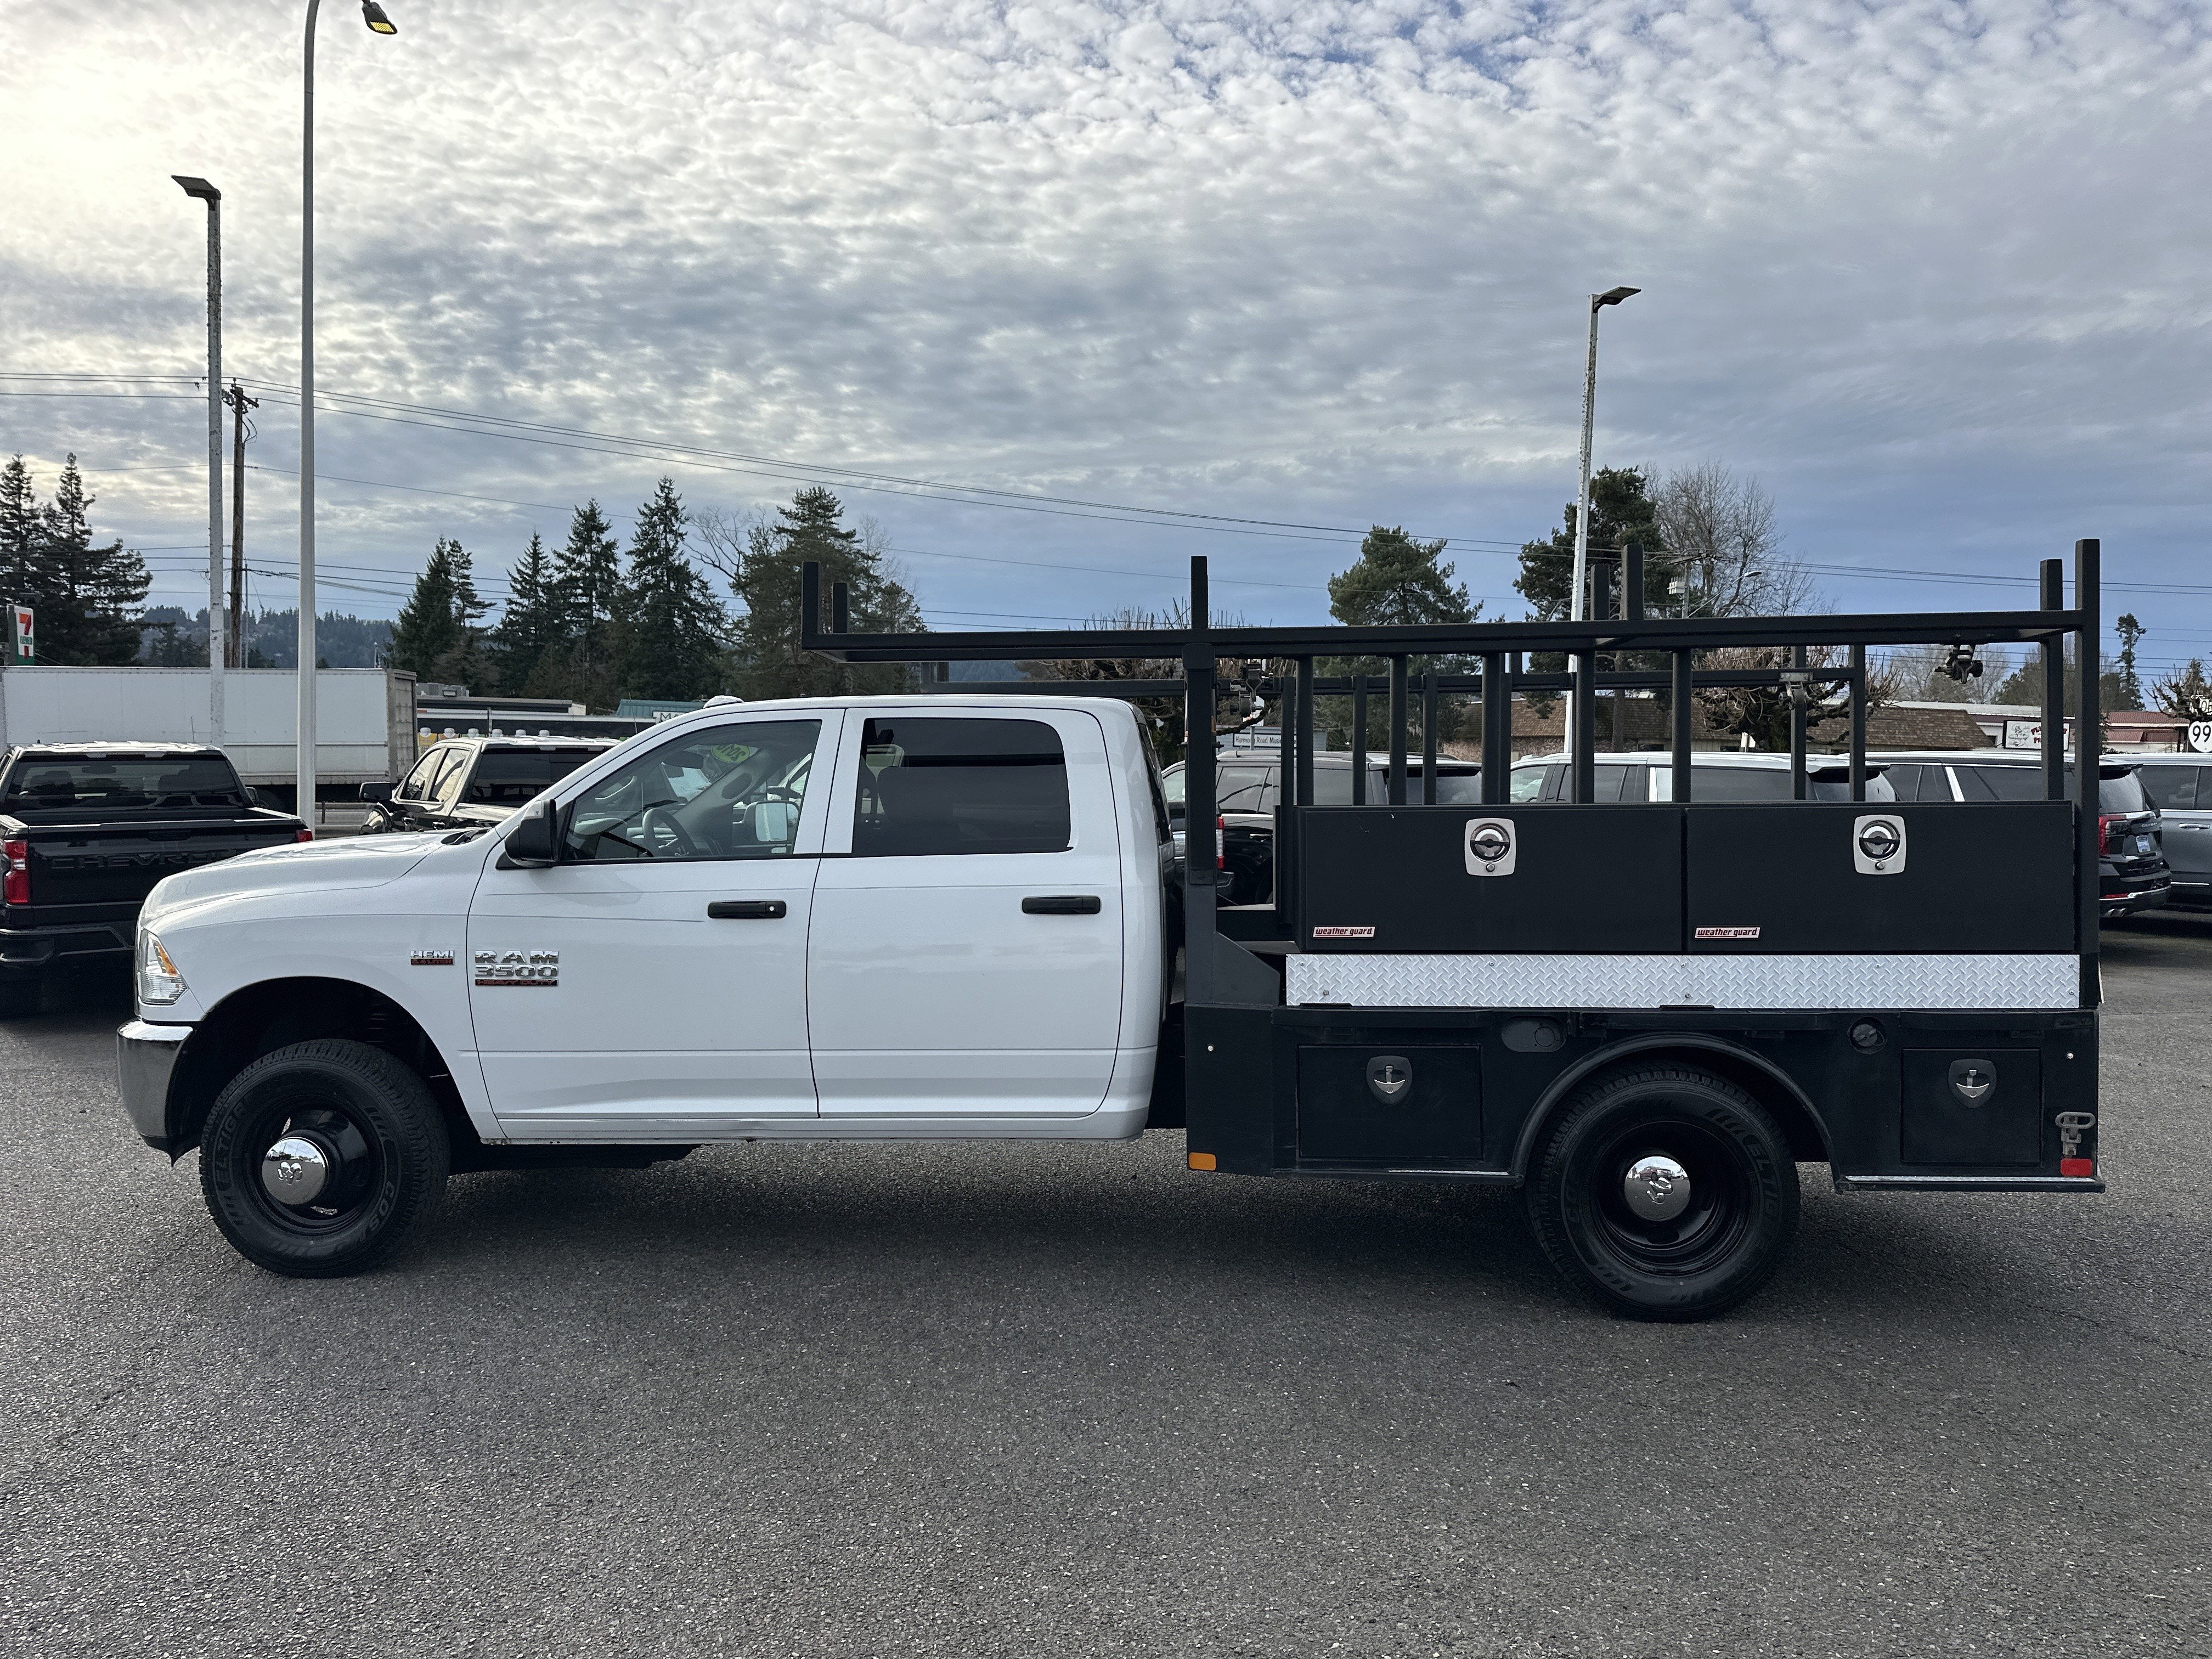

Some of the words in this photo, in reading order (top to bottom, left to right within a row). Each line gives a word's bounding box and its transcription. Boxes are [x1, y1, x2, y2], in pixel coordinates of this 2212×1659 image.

[1350, 927, 1373, 936] guard
[1733, 928, 1758, 936] guard
[475, 950, 558, 964] RAM
[475, 964, 558, 977] 3500
